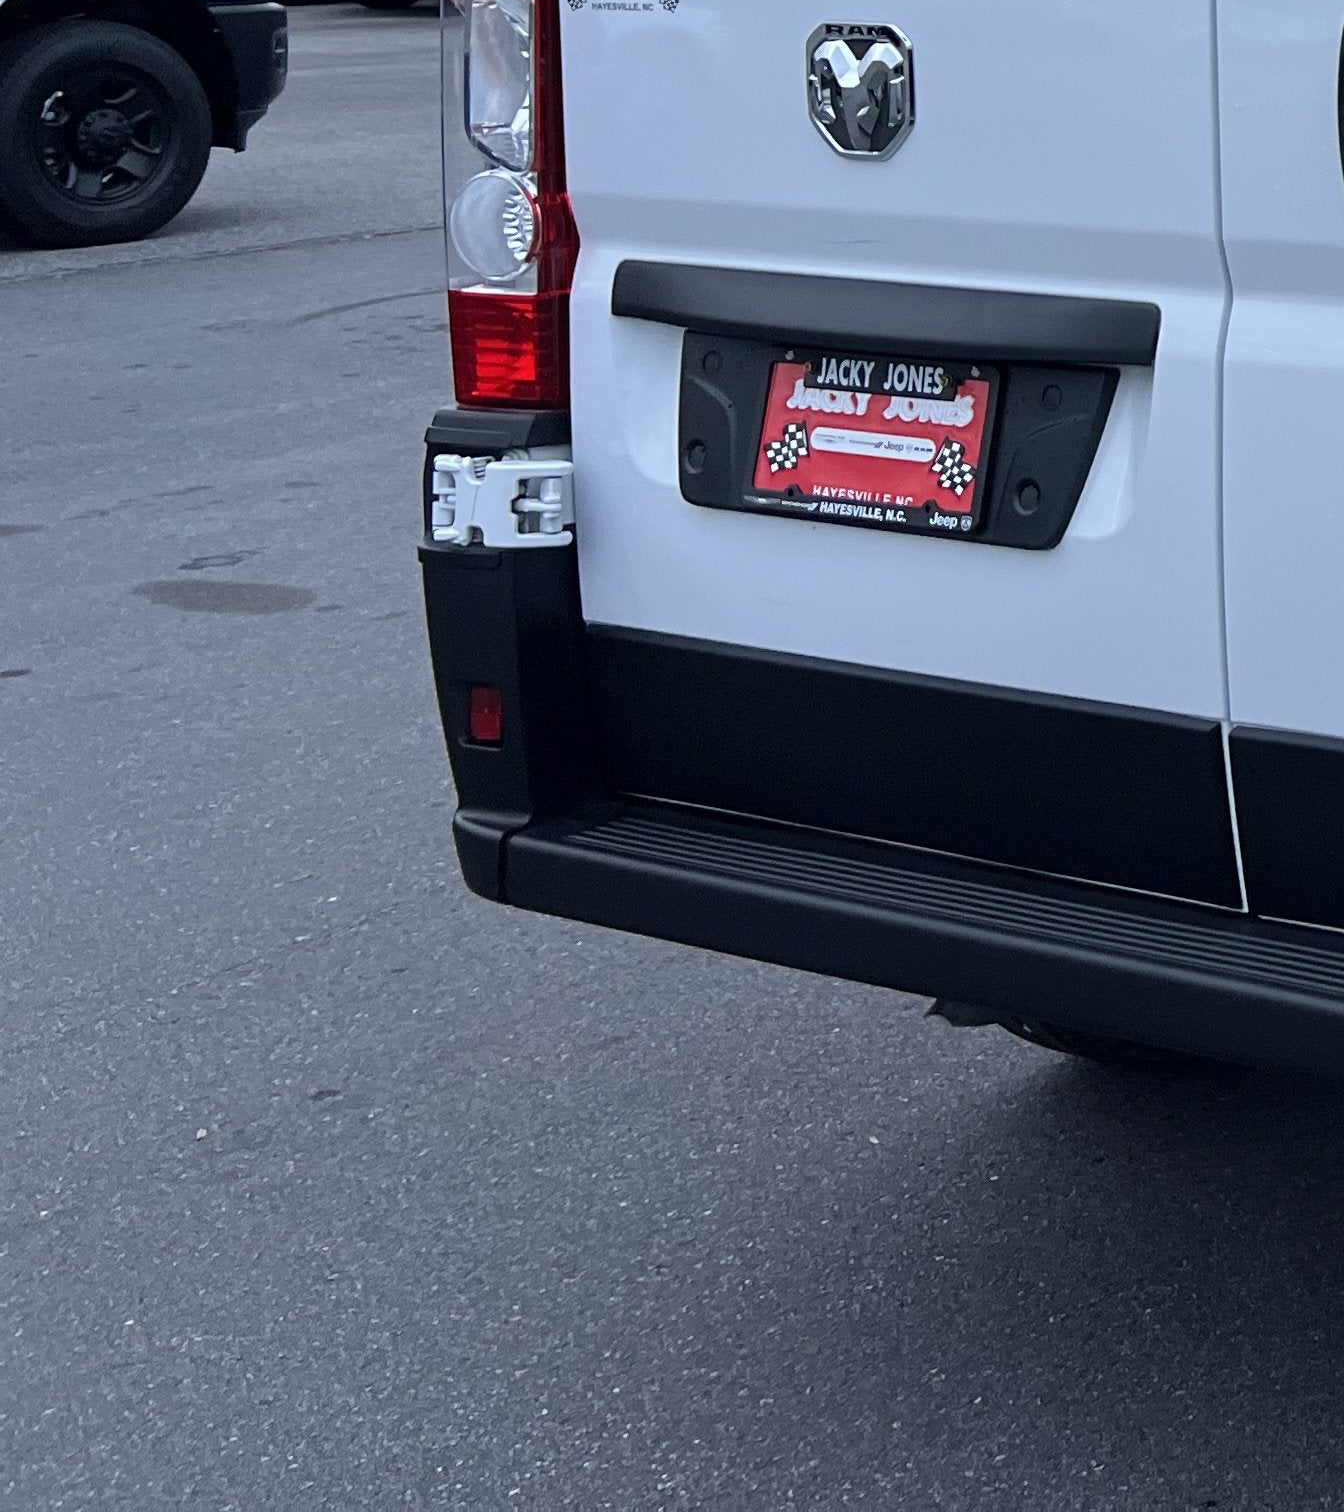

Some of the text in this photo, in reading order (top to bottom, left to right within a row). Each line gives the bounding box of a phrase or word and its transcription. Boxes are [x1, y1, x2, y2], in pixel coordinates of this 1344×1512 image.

[825, 24, 890, 36] RAM
[817, 357, 945, 395] JACKY JONES
[819, 501, 883, 522] HAYESVILLE,
[885, 508, 907, 523] N.C.
[929, 511, 958, 530] Jeep
